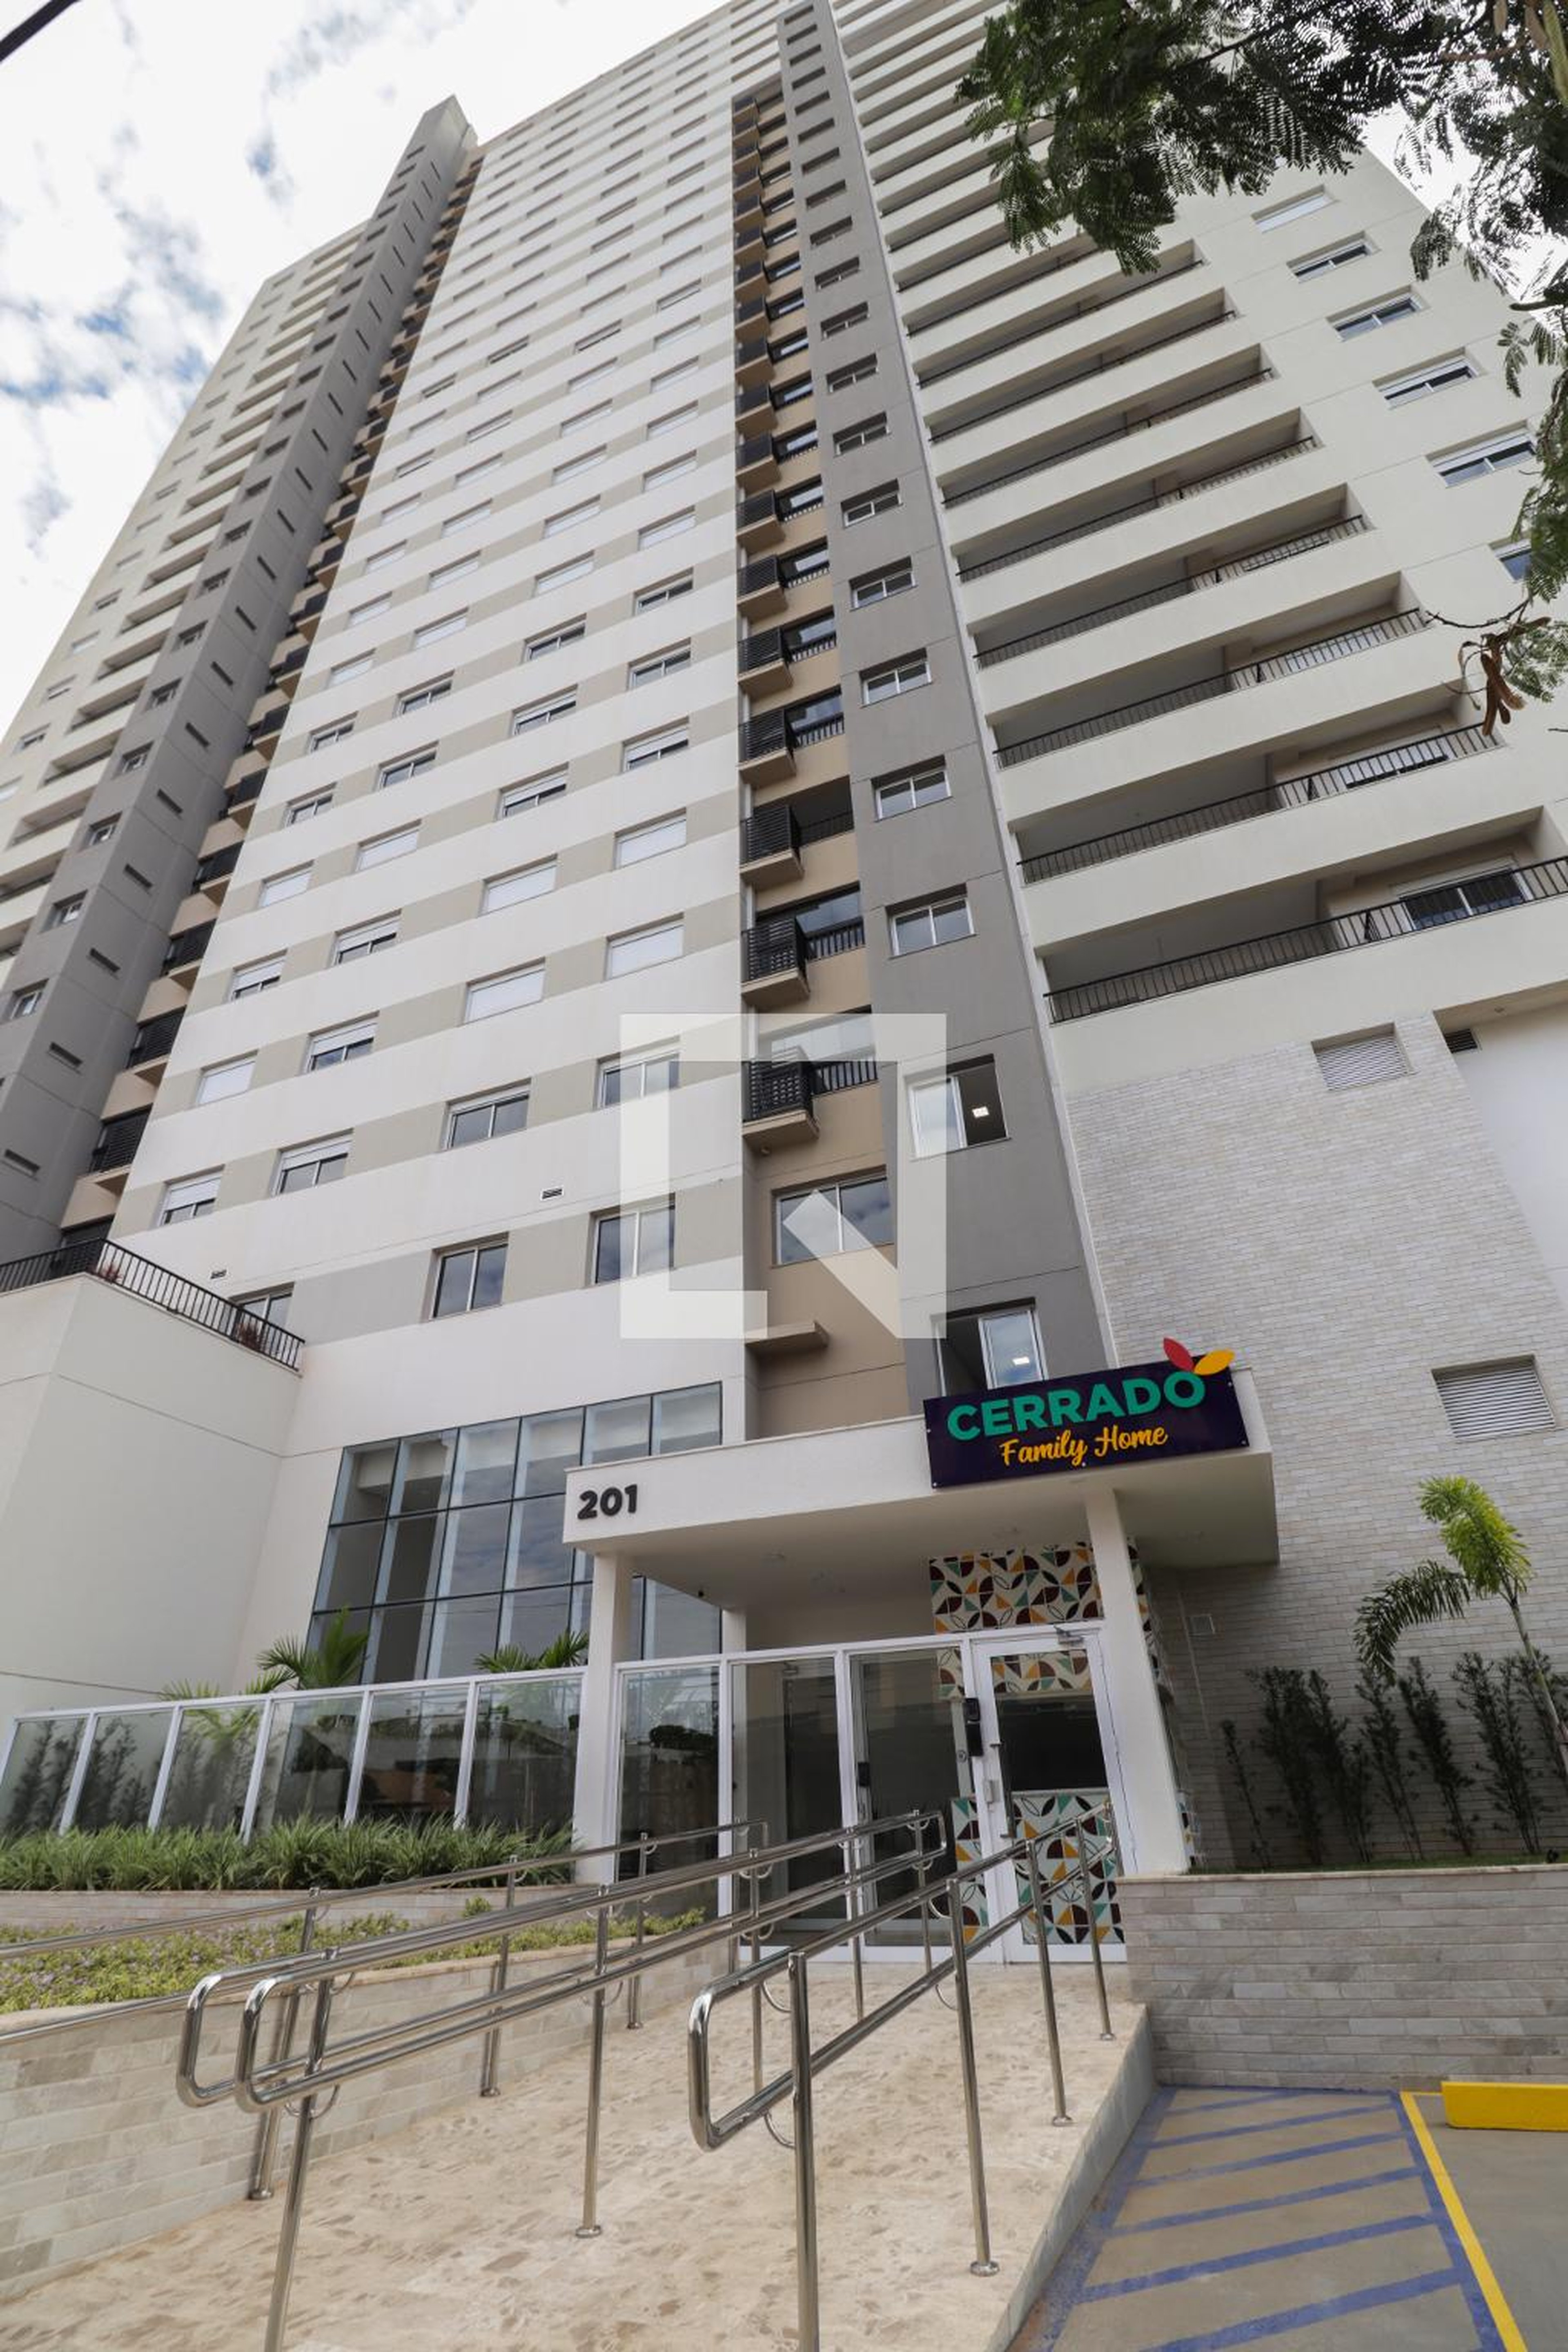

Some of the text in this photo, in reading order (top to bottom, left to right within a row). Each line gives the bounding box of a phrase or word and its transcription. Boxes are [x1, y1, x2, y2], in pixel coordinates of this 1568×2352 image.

[947, 1371, 1205, 1441] CERRADO
[1000, 1424, 1168, 1466] Family Home
[577, 1484, 637, 1520] 201
